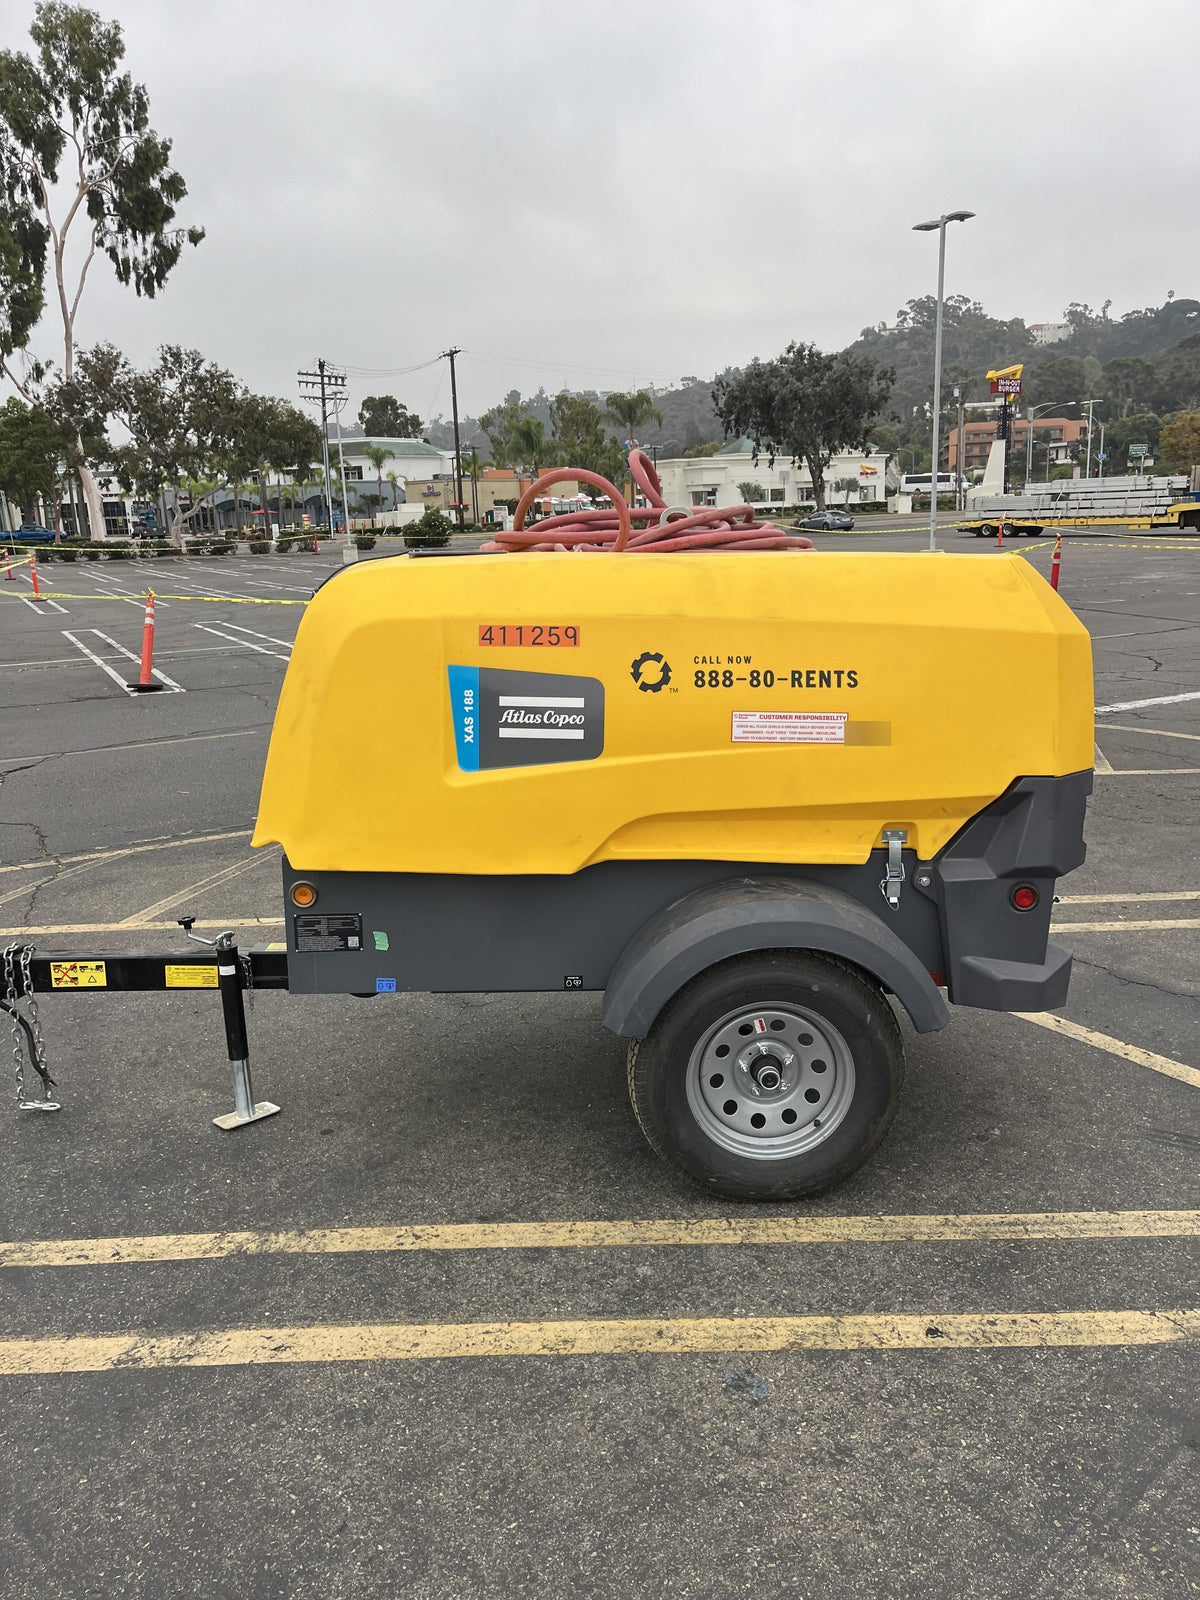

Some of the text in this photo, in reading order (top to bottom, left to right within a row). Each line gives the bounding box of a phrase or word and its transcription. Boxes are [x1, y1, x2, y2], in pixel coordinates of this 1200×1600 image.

[481, 626, 577, 646] 411259
[693, 656, 752, 664] CALL NOW
[694, 670, 859, 688] 888-80-RENTS
[464, 690, 474, 743] XAS 188
[498, 709, 585, 727] Atlas Copco
